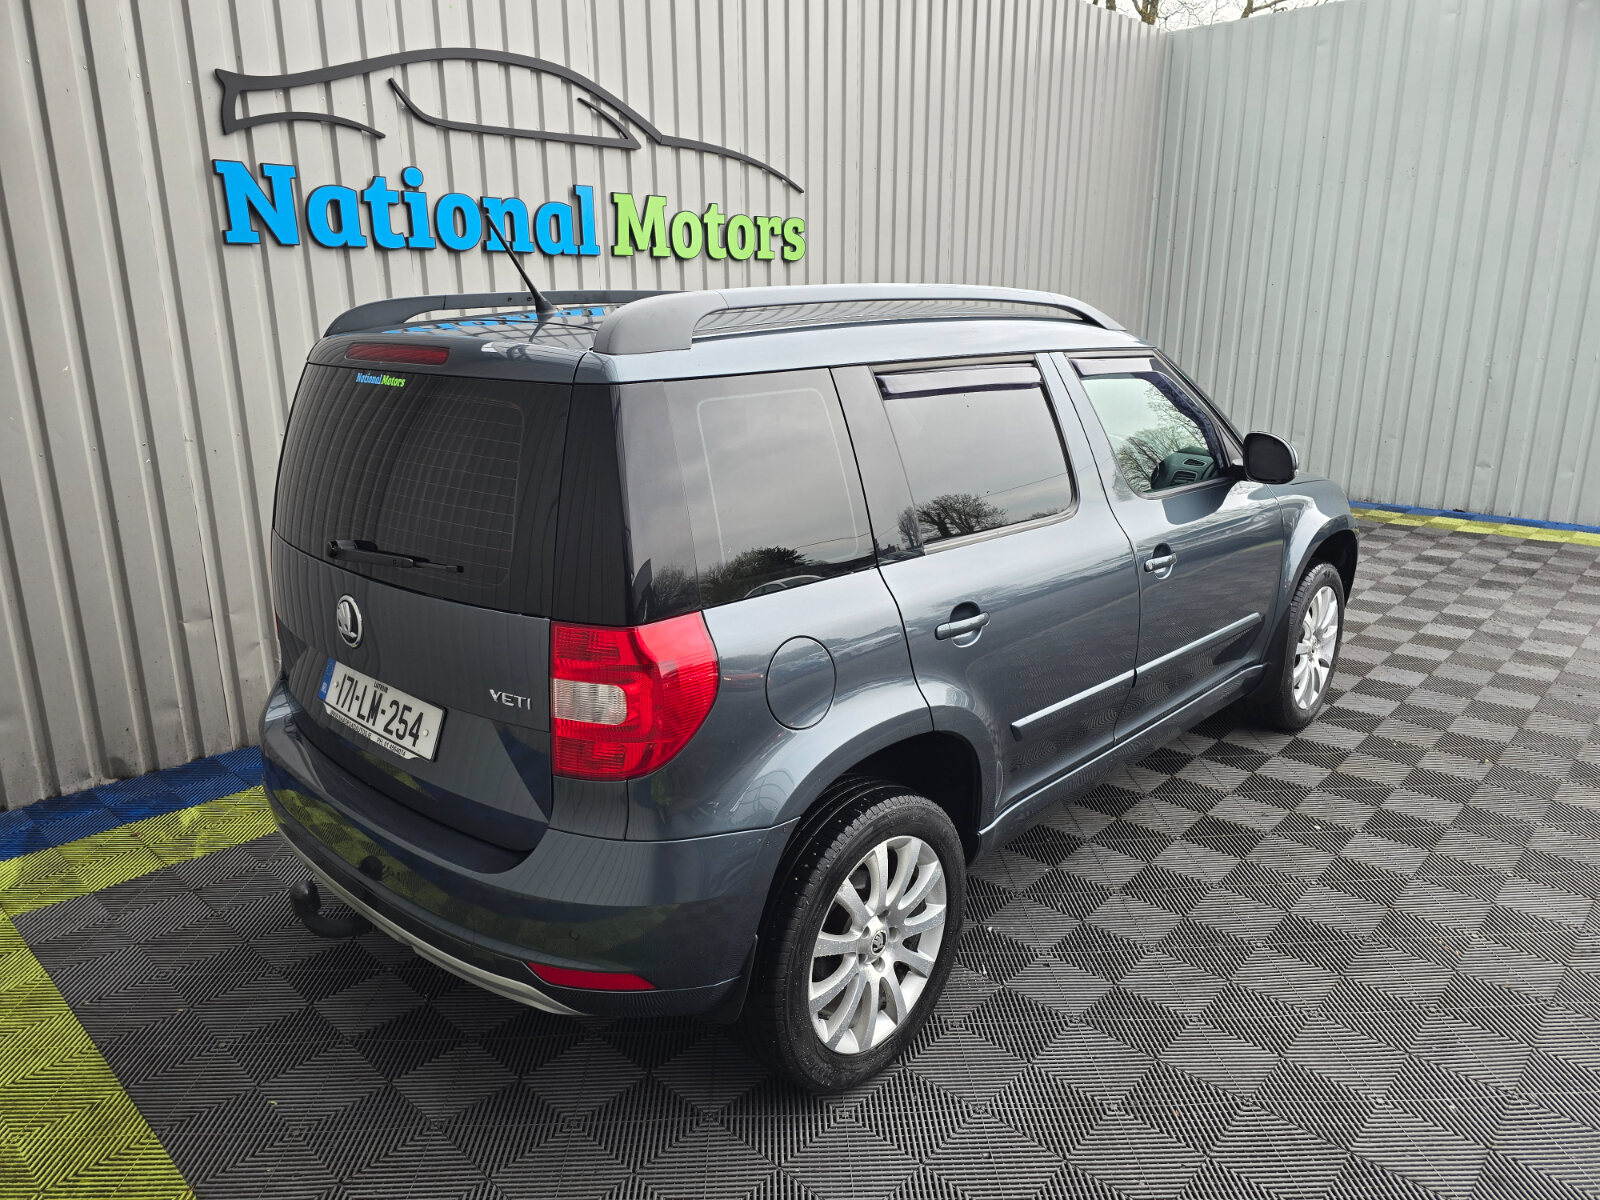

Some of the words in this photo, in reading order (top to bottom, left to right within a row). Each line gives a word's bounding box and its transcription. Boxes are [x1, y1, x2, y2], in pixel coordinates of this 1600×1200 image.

[213, 158, 601, 256] National
[610, 191, 807, 261] Motors
[356, 372, 382, 384] National
[381, 375, 405, 387] Motors
[336, 673, 424, 747] 171-LM-254
[489, 689, 531, 710] YETI
